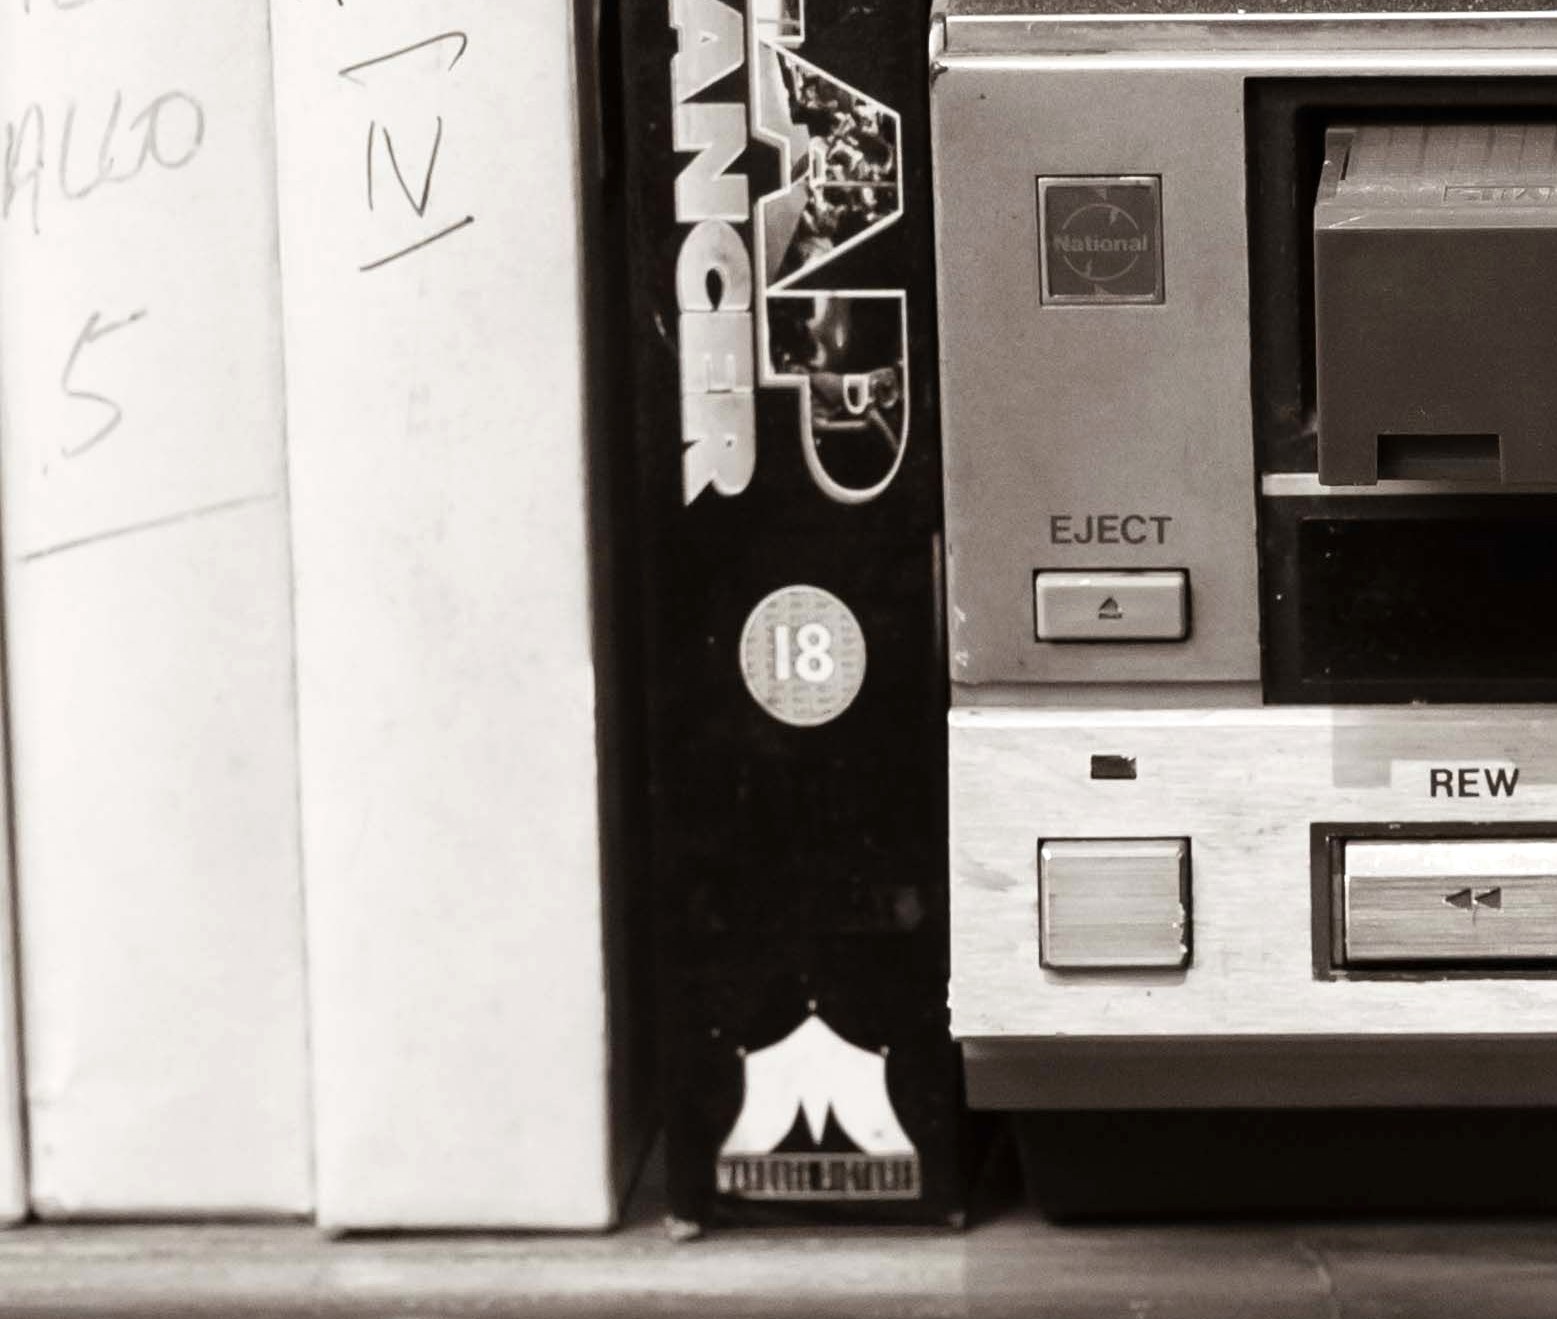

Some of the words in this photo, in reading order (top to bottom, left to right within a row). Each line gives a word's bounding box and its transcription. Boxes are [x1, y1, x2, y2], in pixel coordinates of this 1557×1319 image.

[1, 90, 204, 235] ALLO
[1053, 232, 1149, 253] National
[61, 309, 147, 459] 5
[1050, 514, 1173, 545] EJECT
[775, 623, 834, 682] 18
[1430, 768, 1520, 798] REW
